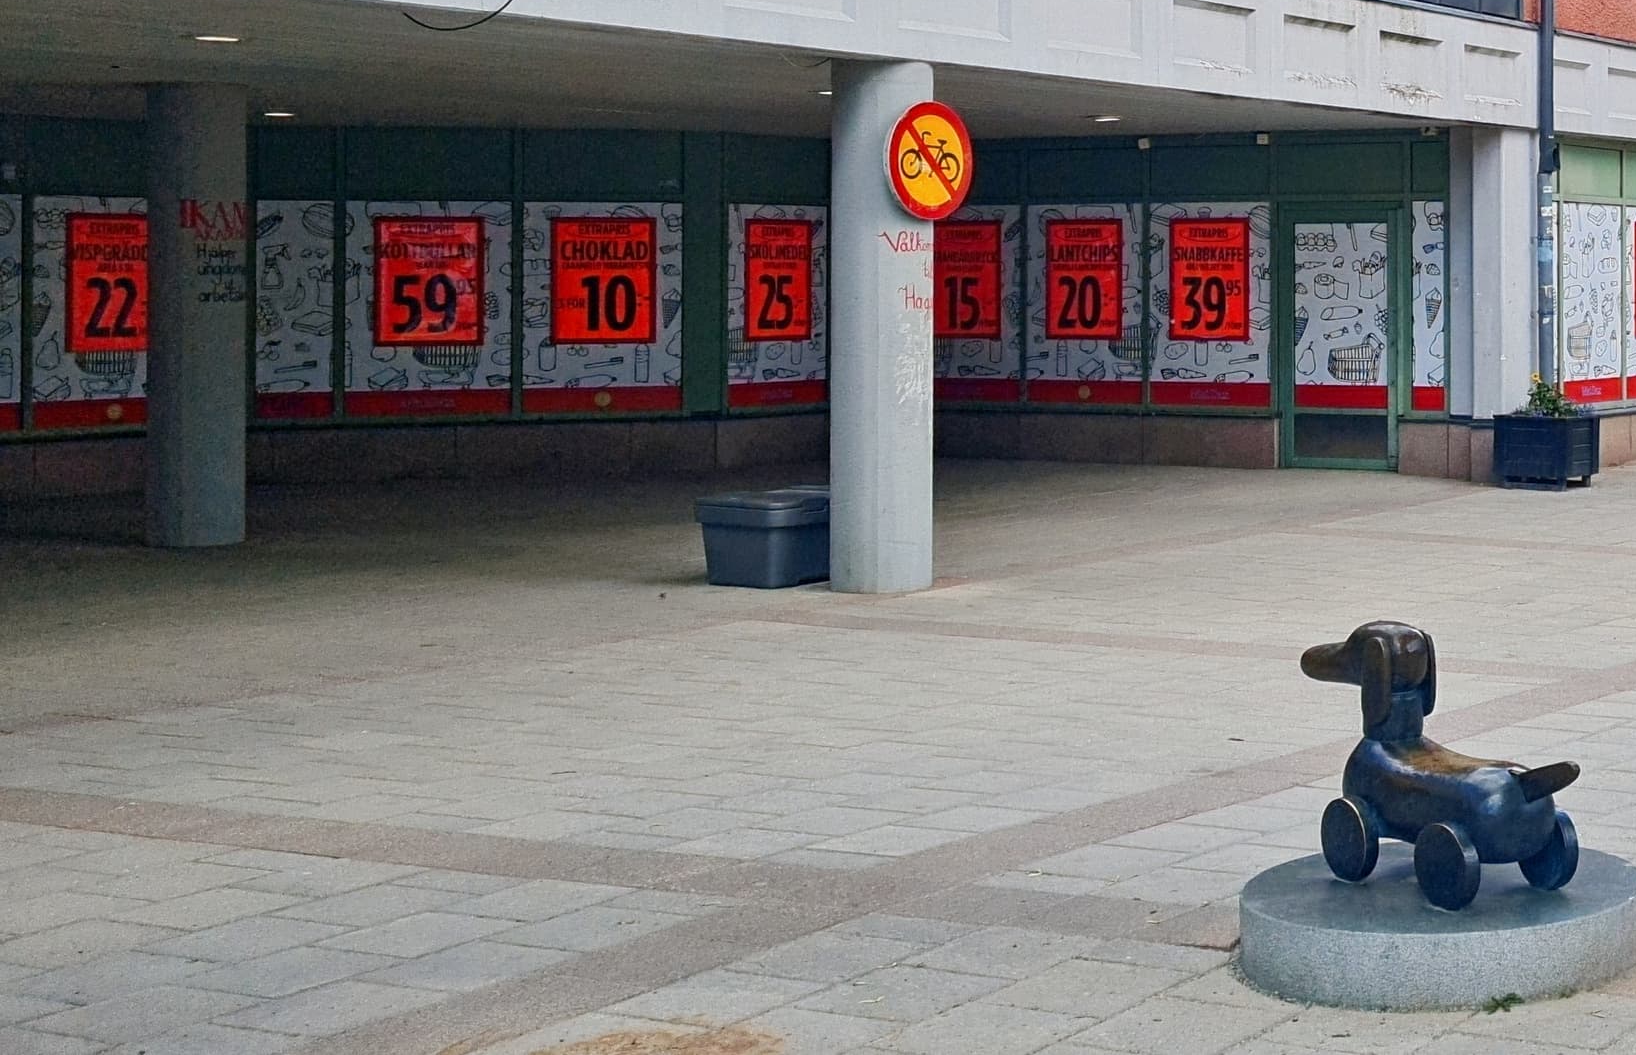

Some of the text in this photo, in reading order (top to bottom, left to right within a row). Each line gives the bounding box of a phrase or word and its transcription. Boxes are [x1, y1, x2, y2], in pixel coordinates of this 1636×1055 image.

[560, 240, 649, 261] CHOKLAD
[577, 224, 631, 235] EXTRAPRIS
[1049, 245, 1119, 263] LANTCHIPS
[1174, 246, 1244, 262] SNABBKAFFE
[85, 277, 138, 338] 22
[392, 274, 457, 334] 59
[581, 275, 637, 331] 10
[757, 274, 794, 330] 25
[944, 276, 980, 330] 15
[1057, 275, 1100, 329] 20
[1180, 276, 1242, 331] 39 95
